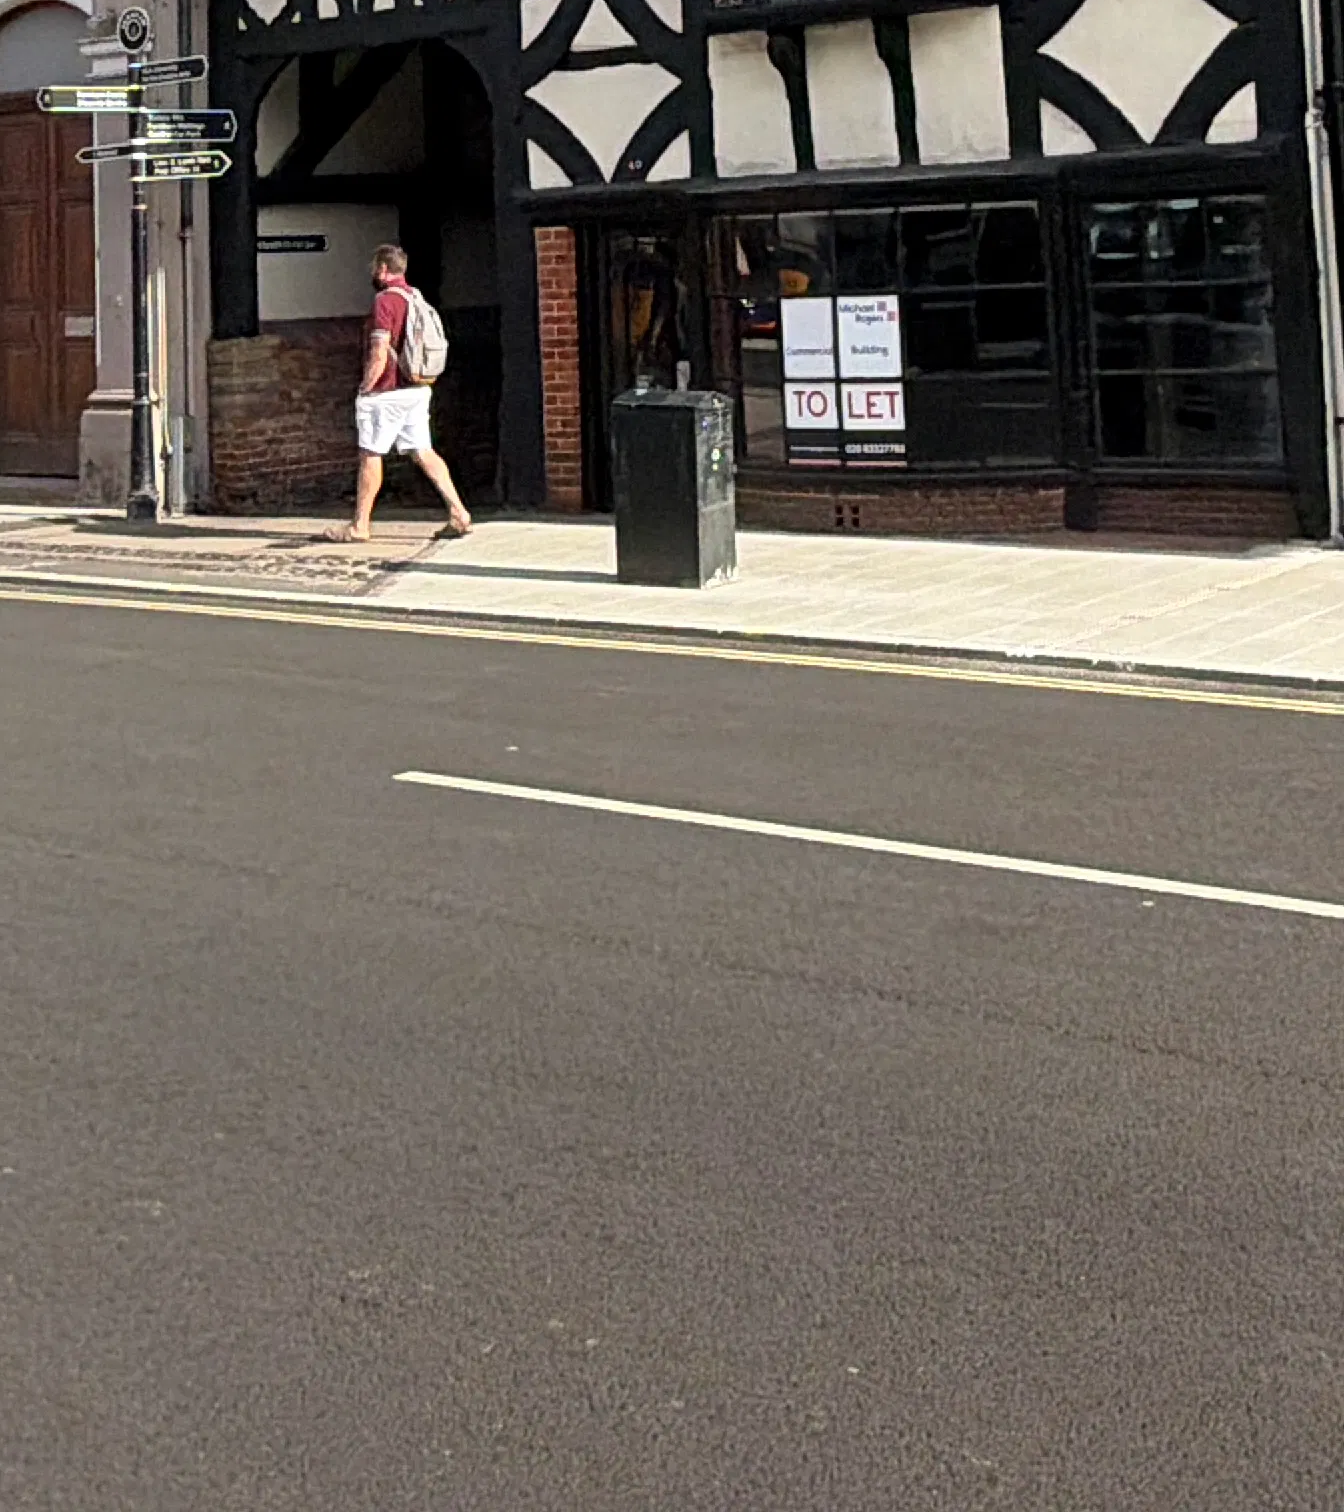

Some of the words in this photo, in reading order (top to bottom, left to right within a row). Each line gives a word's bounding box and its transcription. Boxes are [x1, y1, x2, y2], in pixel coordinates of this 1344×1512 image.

[851, 344, 890, 357] Building
[792, 390, 828, 418] TO
[847, 390, 900, 420] LET
